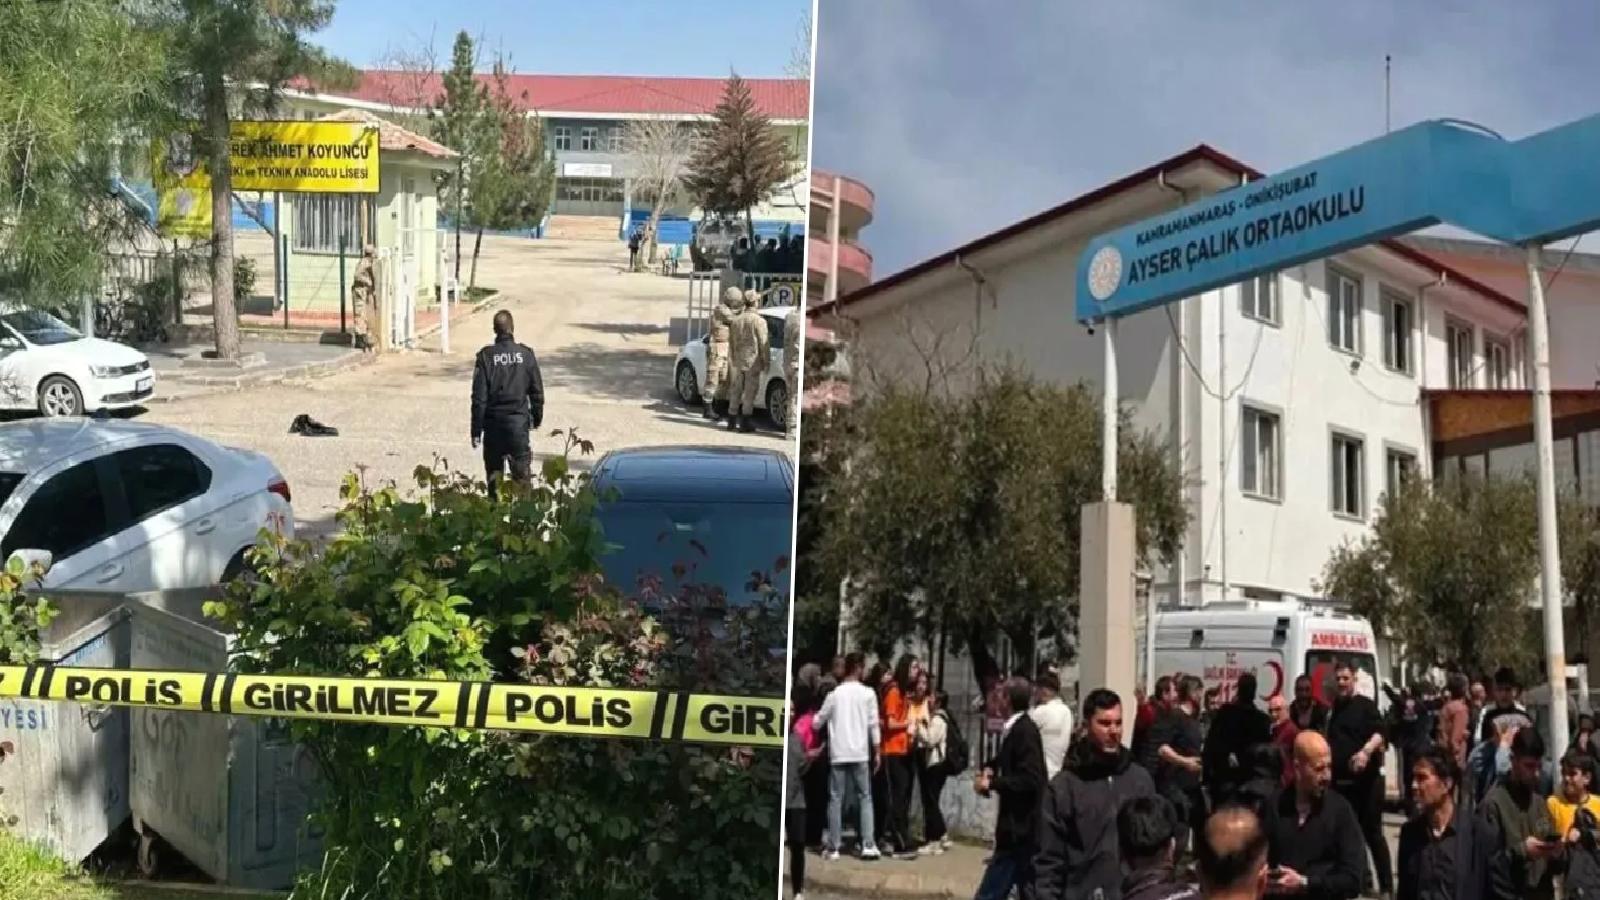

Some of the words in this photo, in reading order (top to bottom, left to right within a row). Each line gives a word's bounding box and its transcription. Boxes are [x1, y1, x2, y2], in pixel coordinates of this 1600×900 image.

[231, 143, 257, 158] REK
[261, 143, 304, 158] AHMET
[308, 144, 369, 159] KOYUNCU
[294, 167, 337, 178] ANADOLU
[1128, 249, 1183, 285] AYSER
[1186, 230, 1239, 273] ÇALIK
[1243, 185, 1365, 248] ORTAOKULU
[1136, 200, 1236, 246] KAHRAMANMARAŞ
